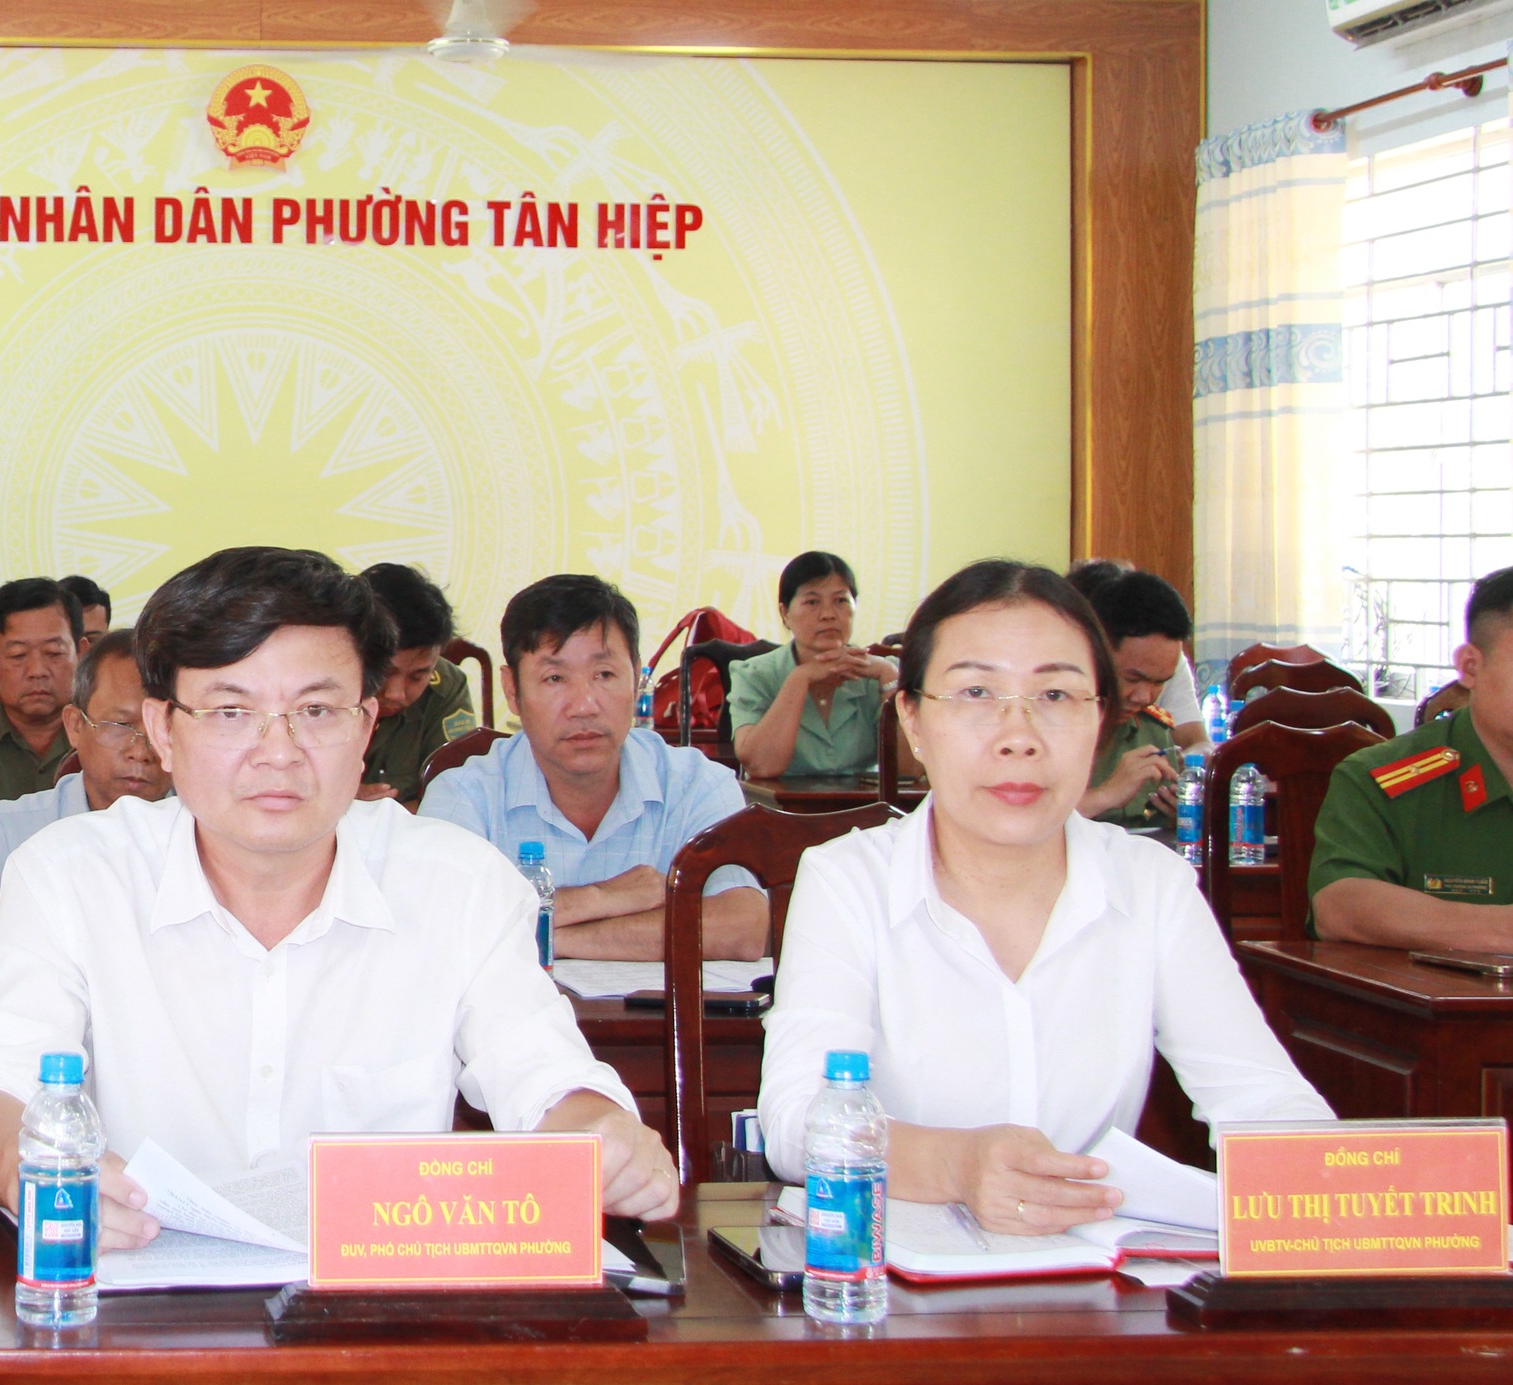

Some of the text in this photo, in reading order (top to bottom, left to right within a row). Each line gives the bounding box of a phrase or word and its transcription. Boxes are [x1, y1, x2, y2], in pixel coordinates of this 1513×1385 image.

[155, 185, 254, 245] DÂN
[271, 185, 469, 247] PHƯỜNG
[490, 187, 579, 248] TÂN
[596, 193, 705, 261] HIỆP
[467, 1158, 493, 1176] CHÍ
[1324, 1147, 1401, 1166] ĐỒNG CHÍ
[373, 1193, 541, 1227] NGÔ VĂN TÔ
[1232, 1185, 1498, 1224] LƯU THỊ TUYẾT TRINH
[871, 1181, 883, 1263] BIWASE
[341, 1239, 572, 1258] ĐUV, PHÓ CHỦ TỊCH UBMTTQVN PHƯỜNG
[1322, 1238, 1351, 1253] TỊCH
[1353, 1236, 1422, 1250] UBMTTQVN
[1424, 1233, 1481, 1249] PHƯỜNG
